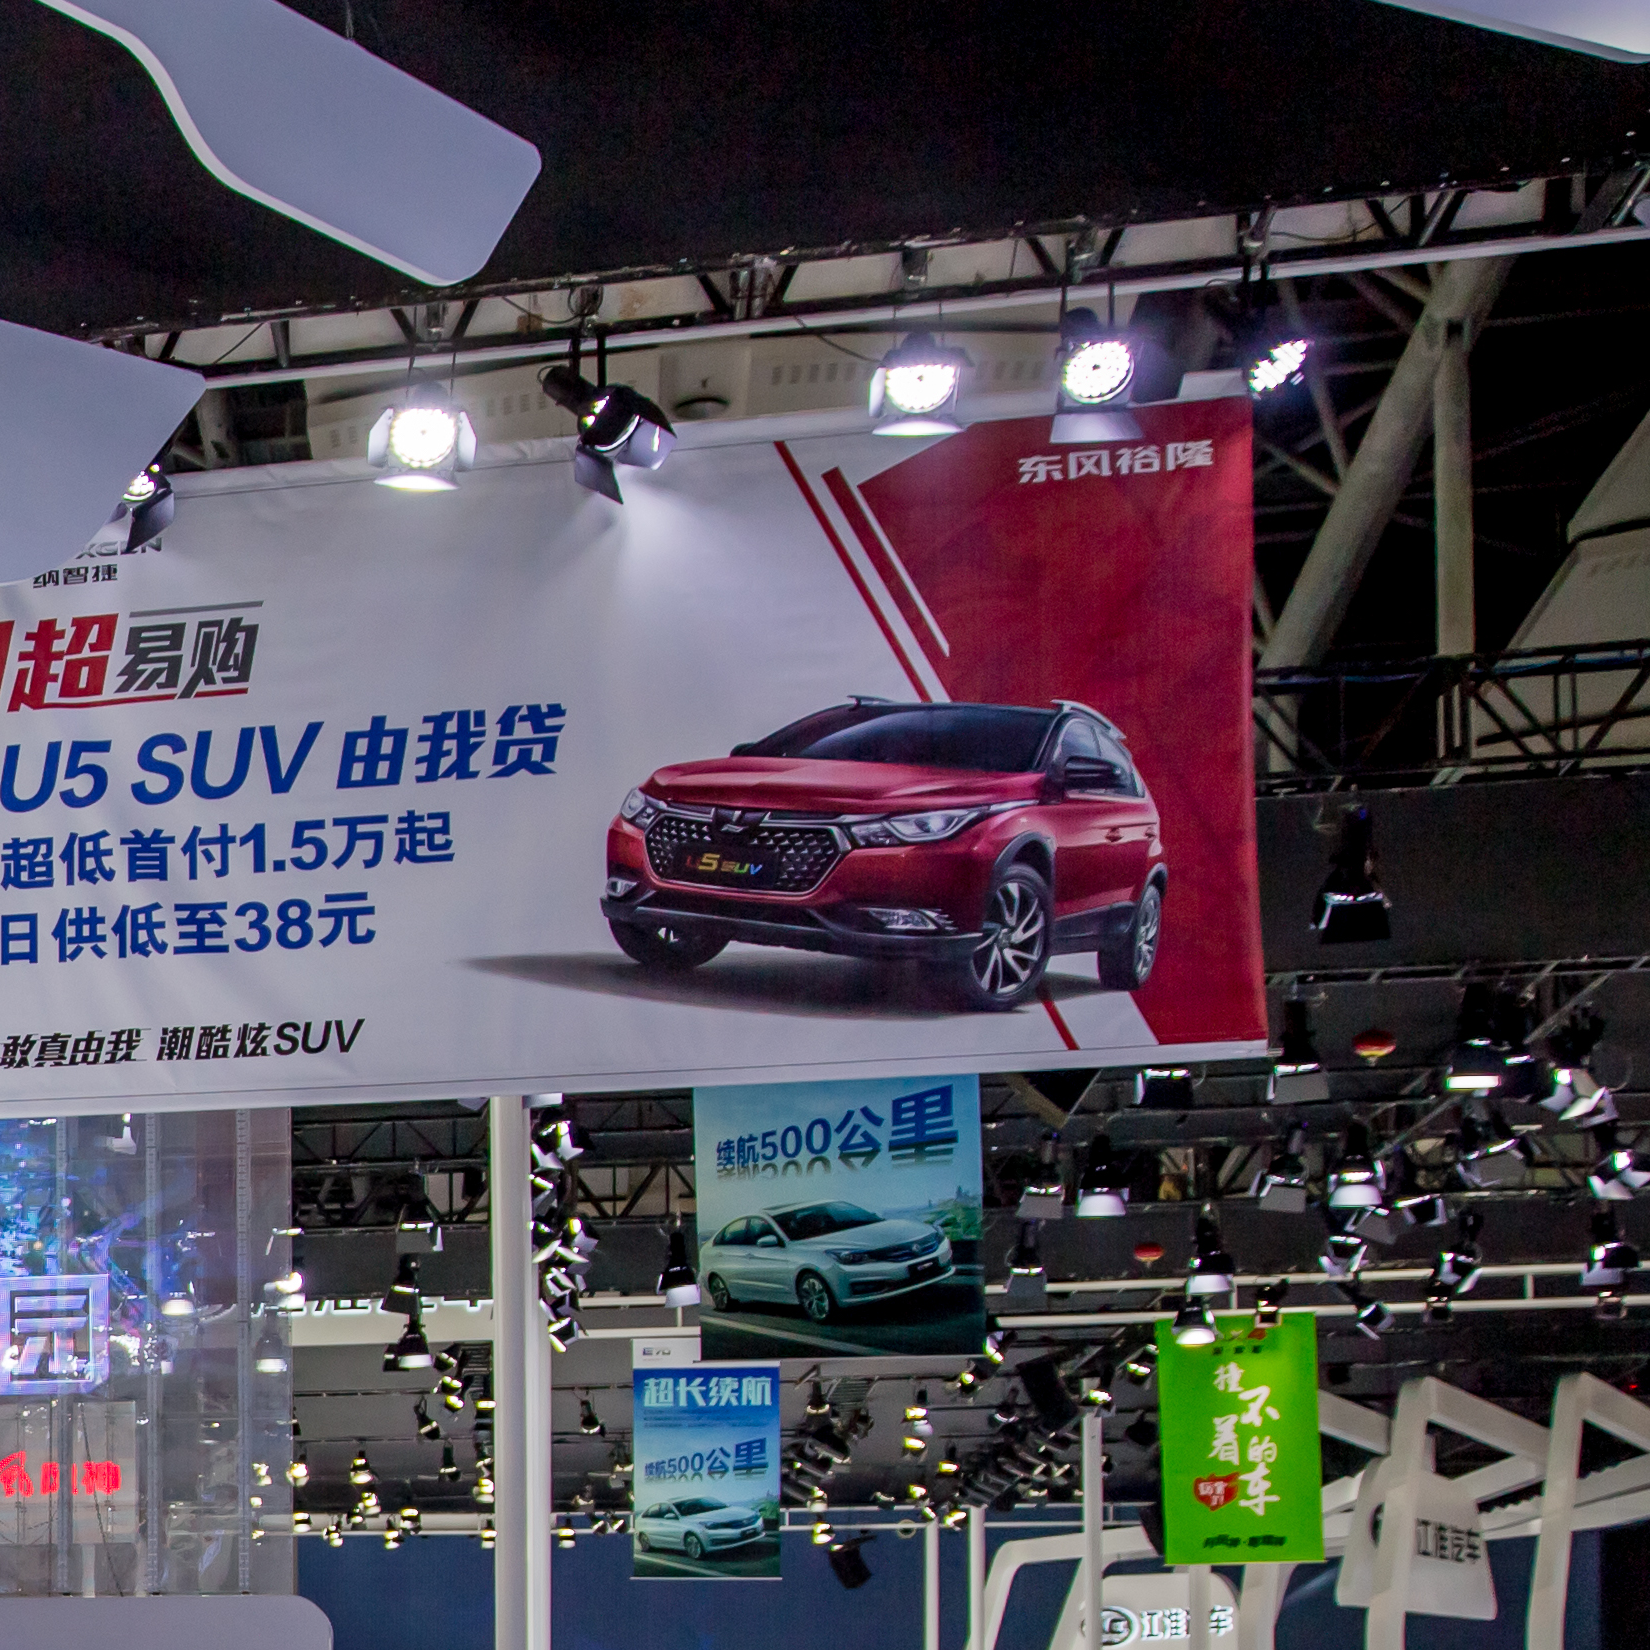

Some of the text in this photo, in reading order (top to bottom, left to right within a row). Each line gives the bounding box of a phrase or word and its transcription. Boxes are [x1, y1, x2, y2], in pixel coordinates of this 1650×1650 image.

[1018, 440, 1213, 483] 东风裕隆
[0, 703, 568, 812] U5 SUV 由我贷
[0, 810, 456, 890] 超低首付1.5万起
[0, 891, 377, 965] 日供低至38元
[156, 1017, 365, 1061] 潮酷炫SUV
[716, 1083, 959, 1168] 续航500公里
[643, 1376, 773, 1408] 超长续航
[1140, 1604, 1234, 1642] 江淮车
